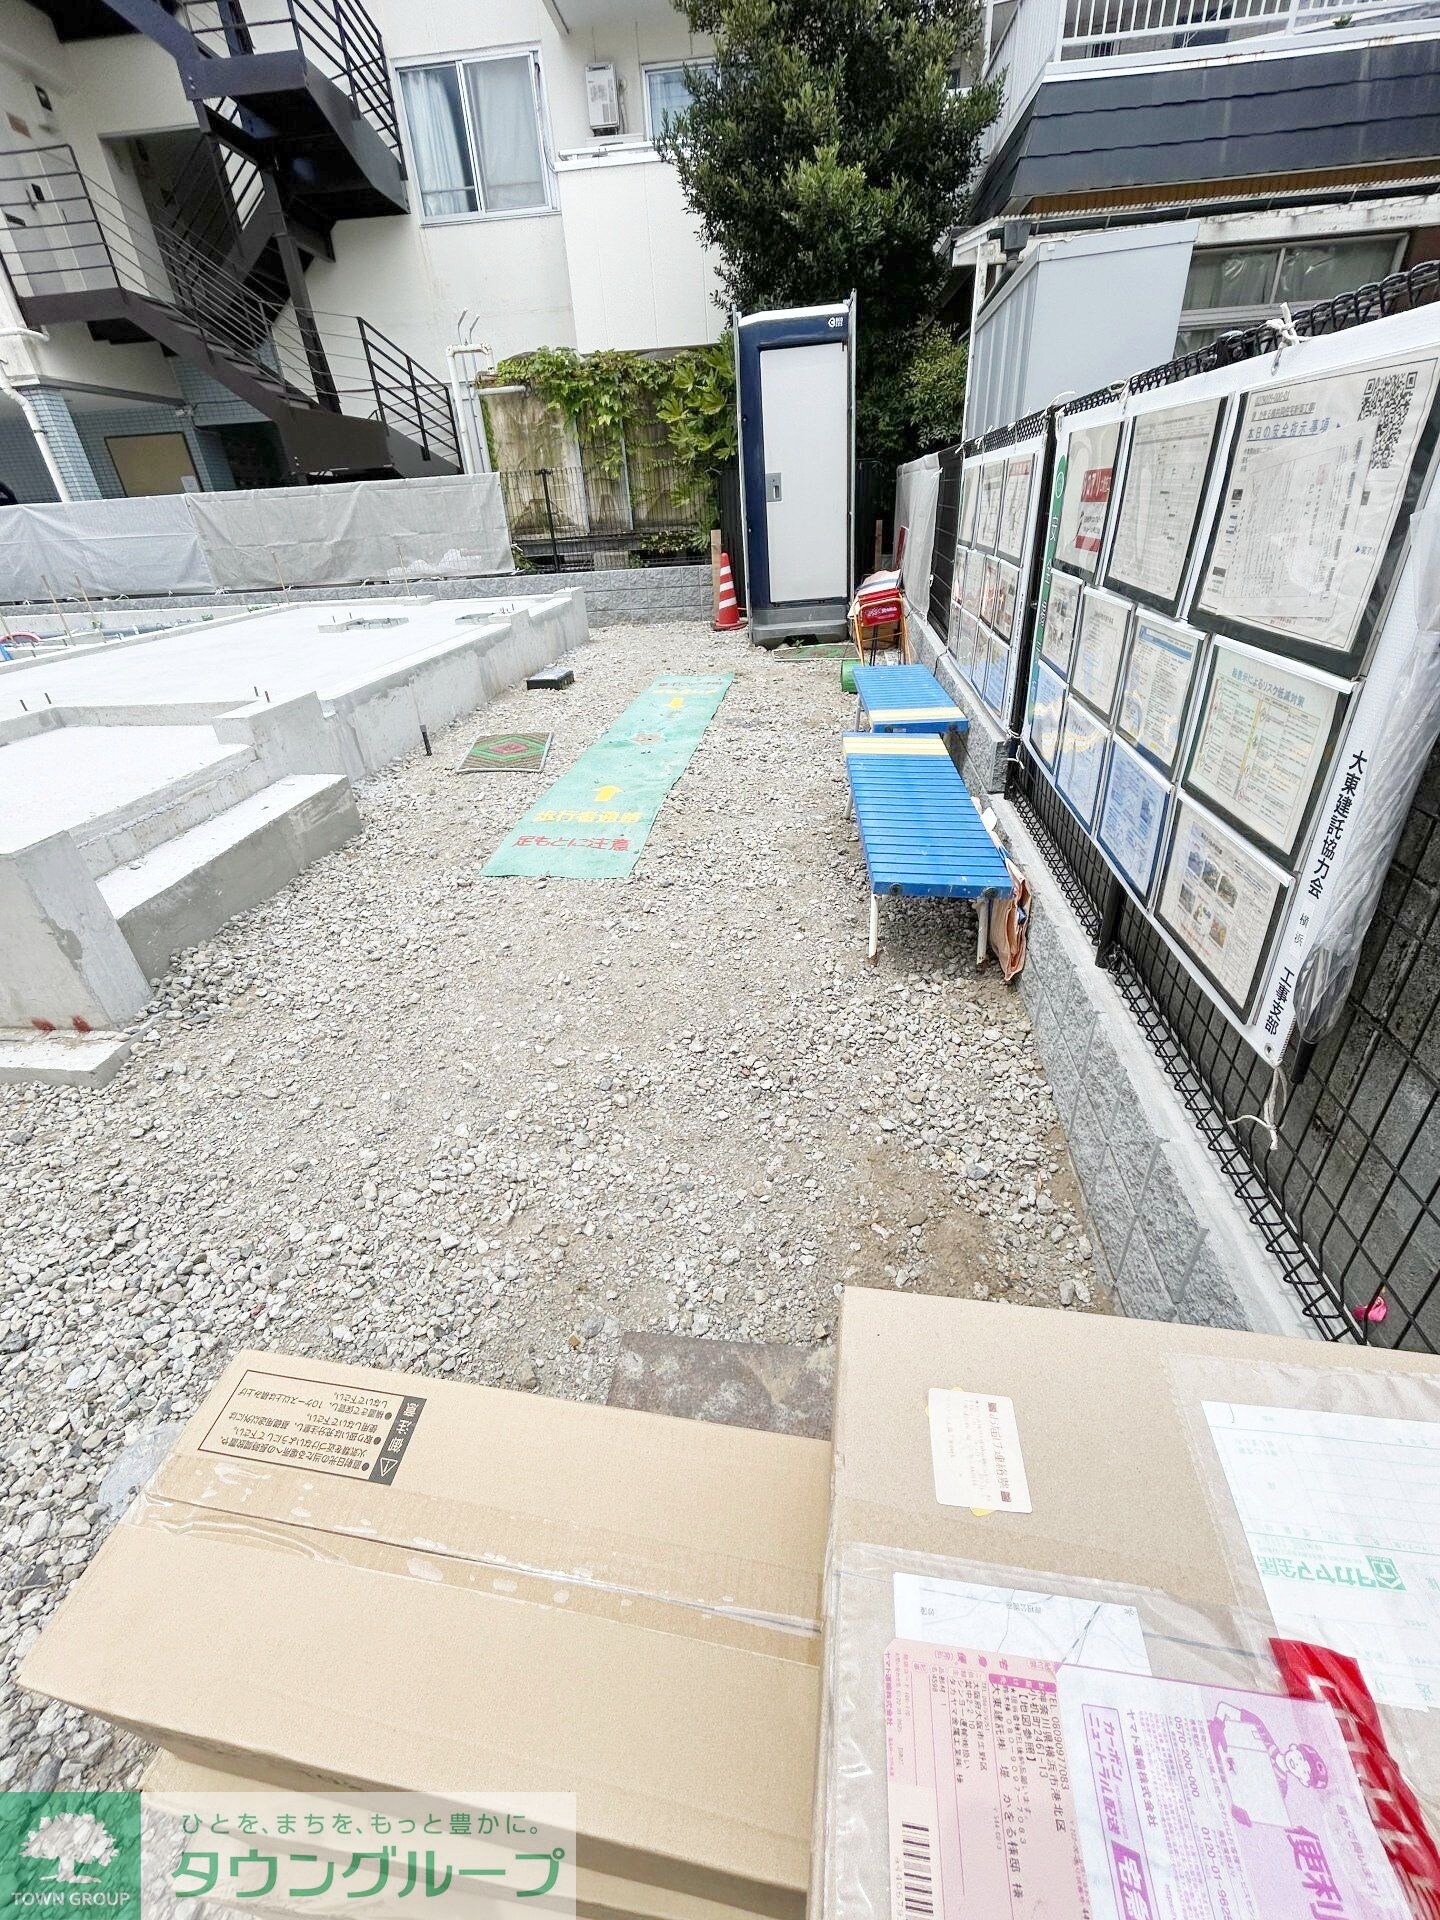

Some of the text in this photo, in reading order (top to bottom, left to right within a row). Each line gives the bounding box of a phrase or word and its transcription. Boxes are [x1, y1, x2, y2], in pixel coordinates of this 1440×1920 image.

[511, 834, 632, 852] 足もとに注意
[1264, 751, 1368, 1036] 大東建託協力会 横浜 工事支部
[388, 1402, 419, 1453] 御注意
[1028, 1690, 1048, 1778] 小机町2461-13
[1049, 1693, 1058, 1709] TEL
[1038, 1691, 1066, 1832] 神奈川県横浜市港北区
[1088, 1713, 1121, 1834] ニュートラル配送
[1103, 1722, 1125, 1781] カーボン
[1126, 1710, 1158, 1827] ヤマト運輸株式会社
[1014, 1883, 1023, 1899] 様
